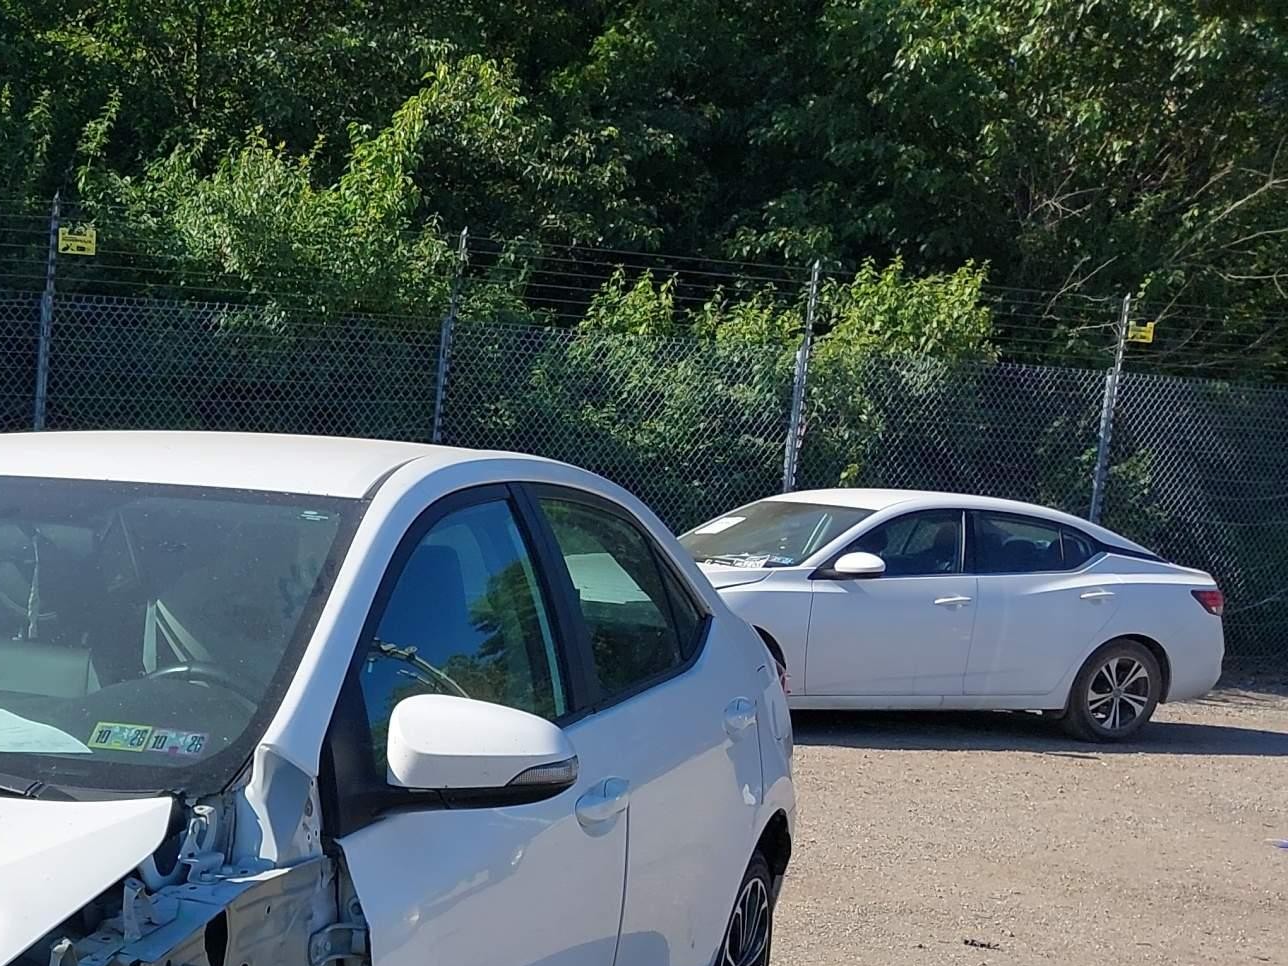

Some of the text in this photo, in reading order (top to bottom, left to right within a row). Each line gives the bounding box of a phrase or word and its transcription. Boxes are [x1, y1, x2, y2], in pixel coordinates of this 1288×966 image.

[95, 729, 148, 747] 10 26
[152, 735, 205, 753] 10 26
